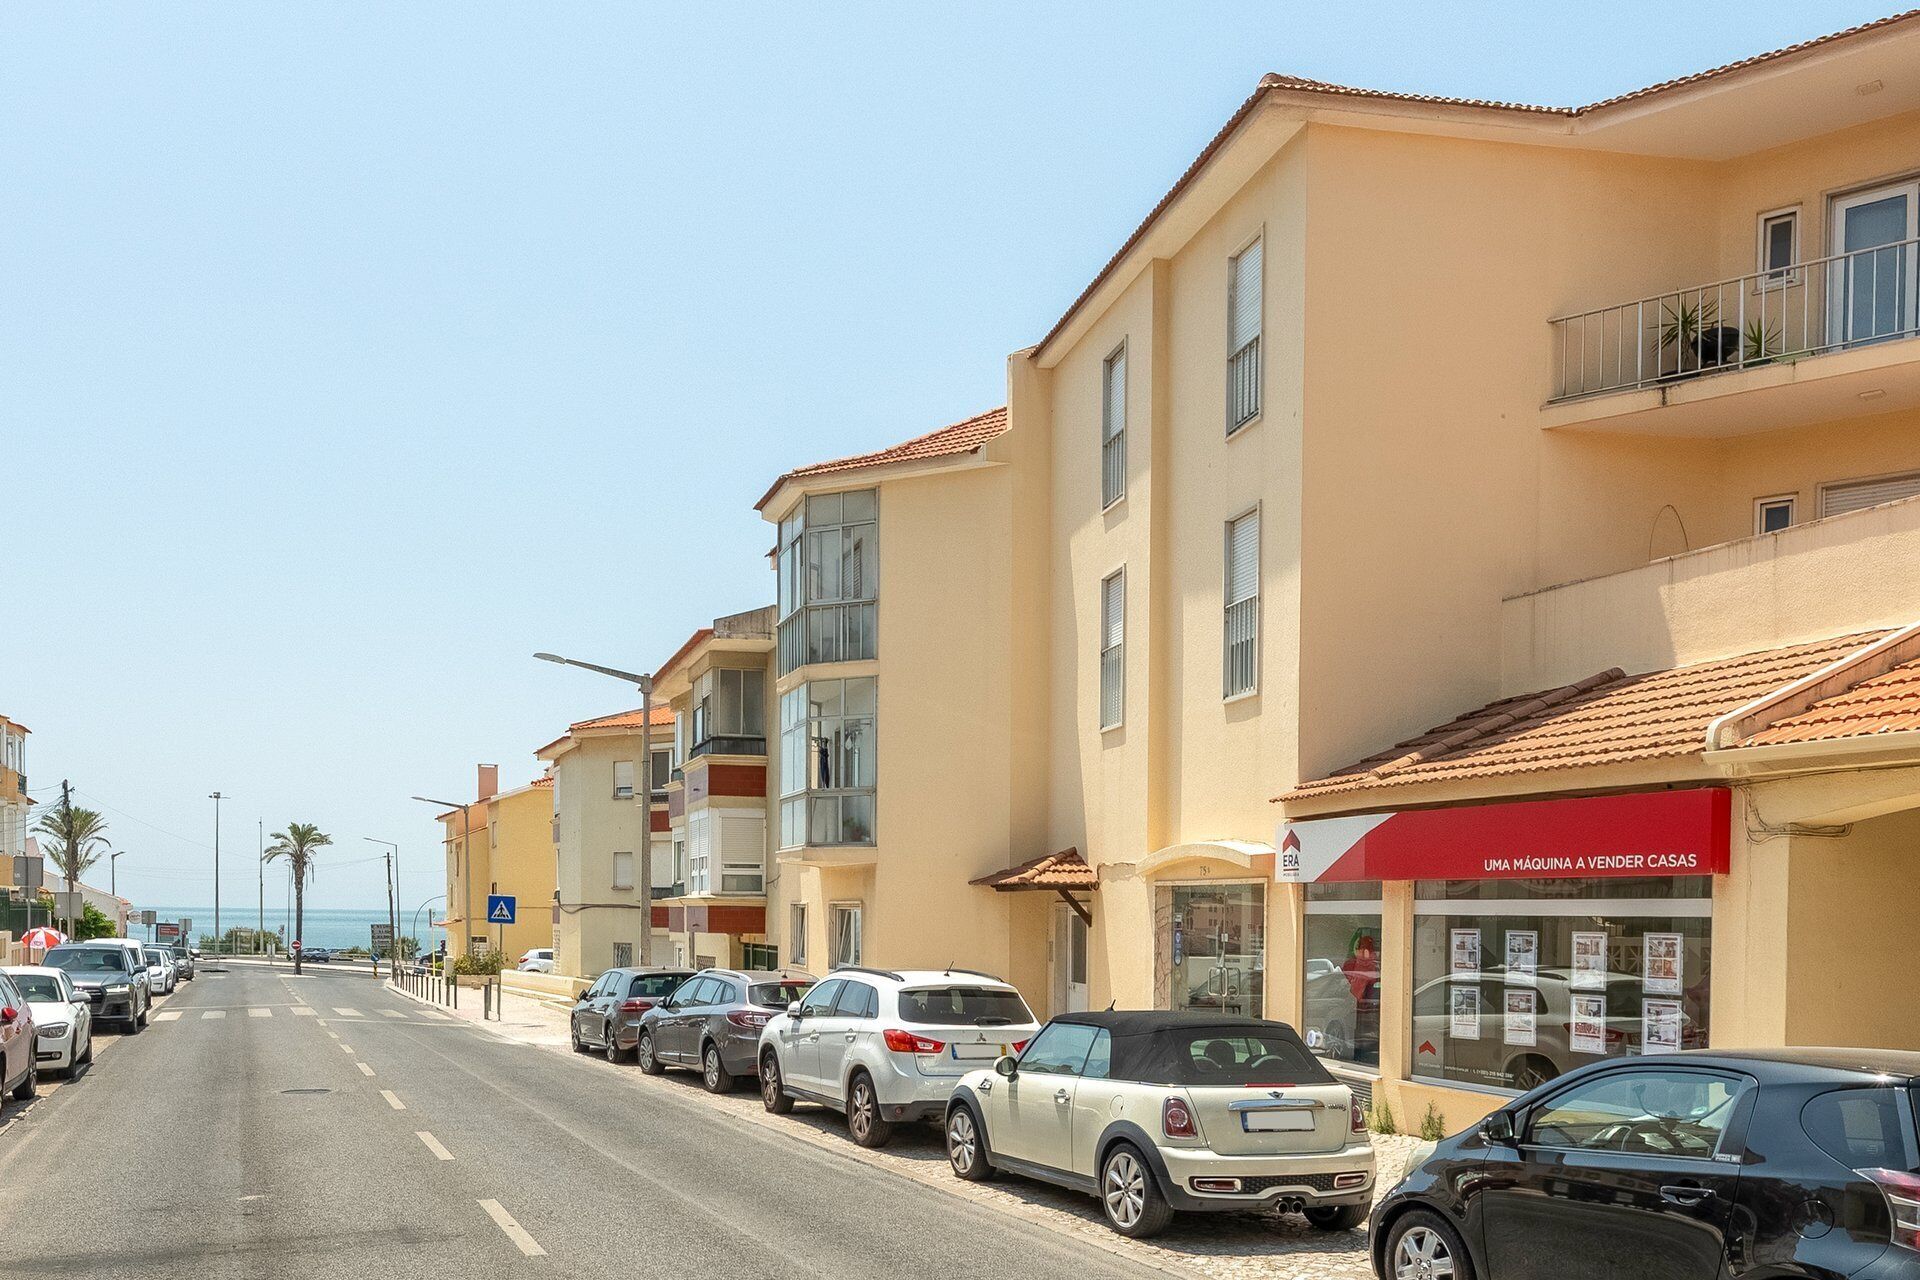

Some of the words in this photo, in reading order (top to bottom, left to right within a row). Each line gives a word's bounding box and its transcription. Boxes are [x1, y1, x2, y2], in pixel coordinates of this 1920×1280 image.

[1283, 854, 1299, 867] ERA
[1484, 859, 1510, 871] UMA
[1513, 855, 1572, 870] MÁQUINA
[1576, 857, 1585, 870] A
[1588, 854, 1644, 869] VENDER
[1648, 854, 1697, 868] CASAS
